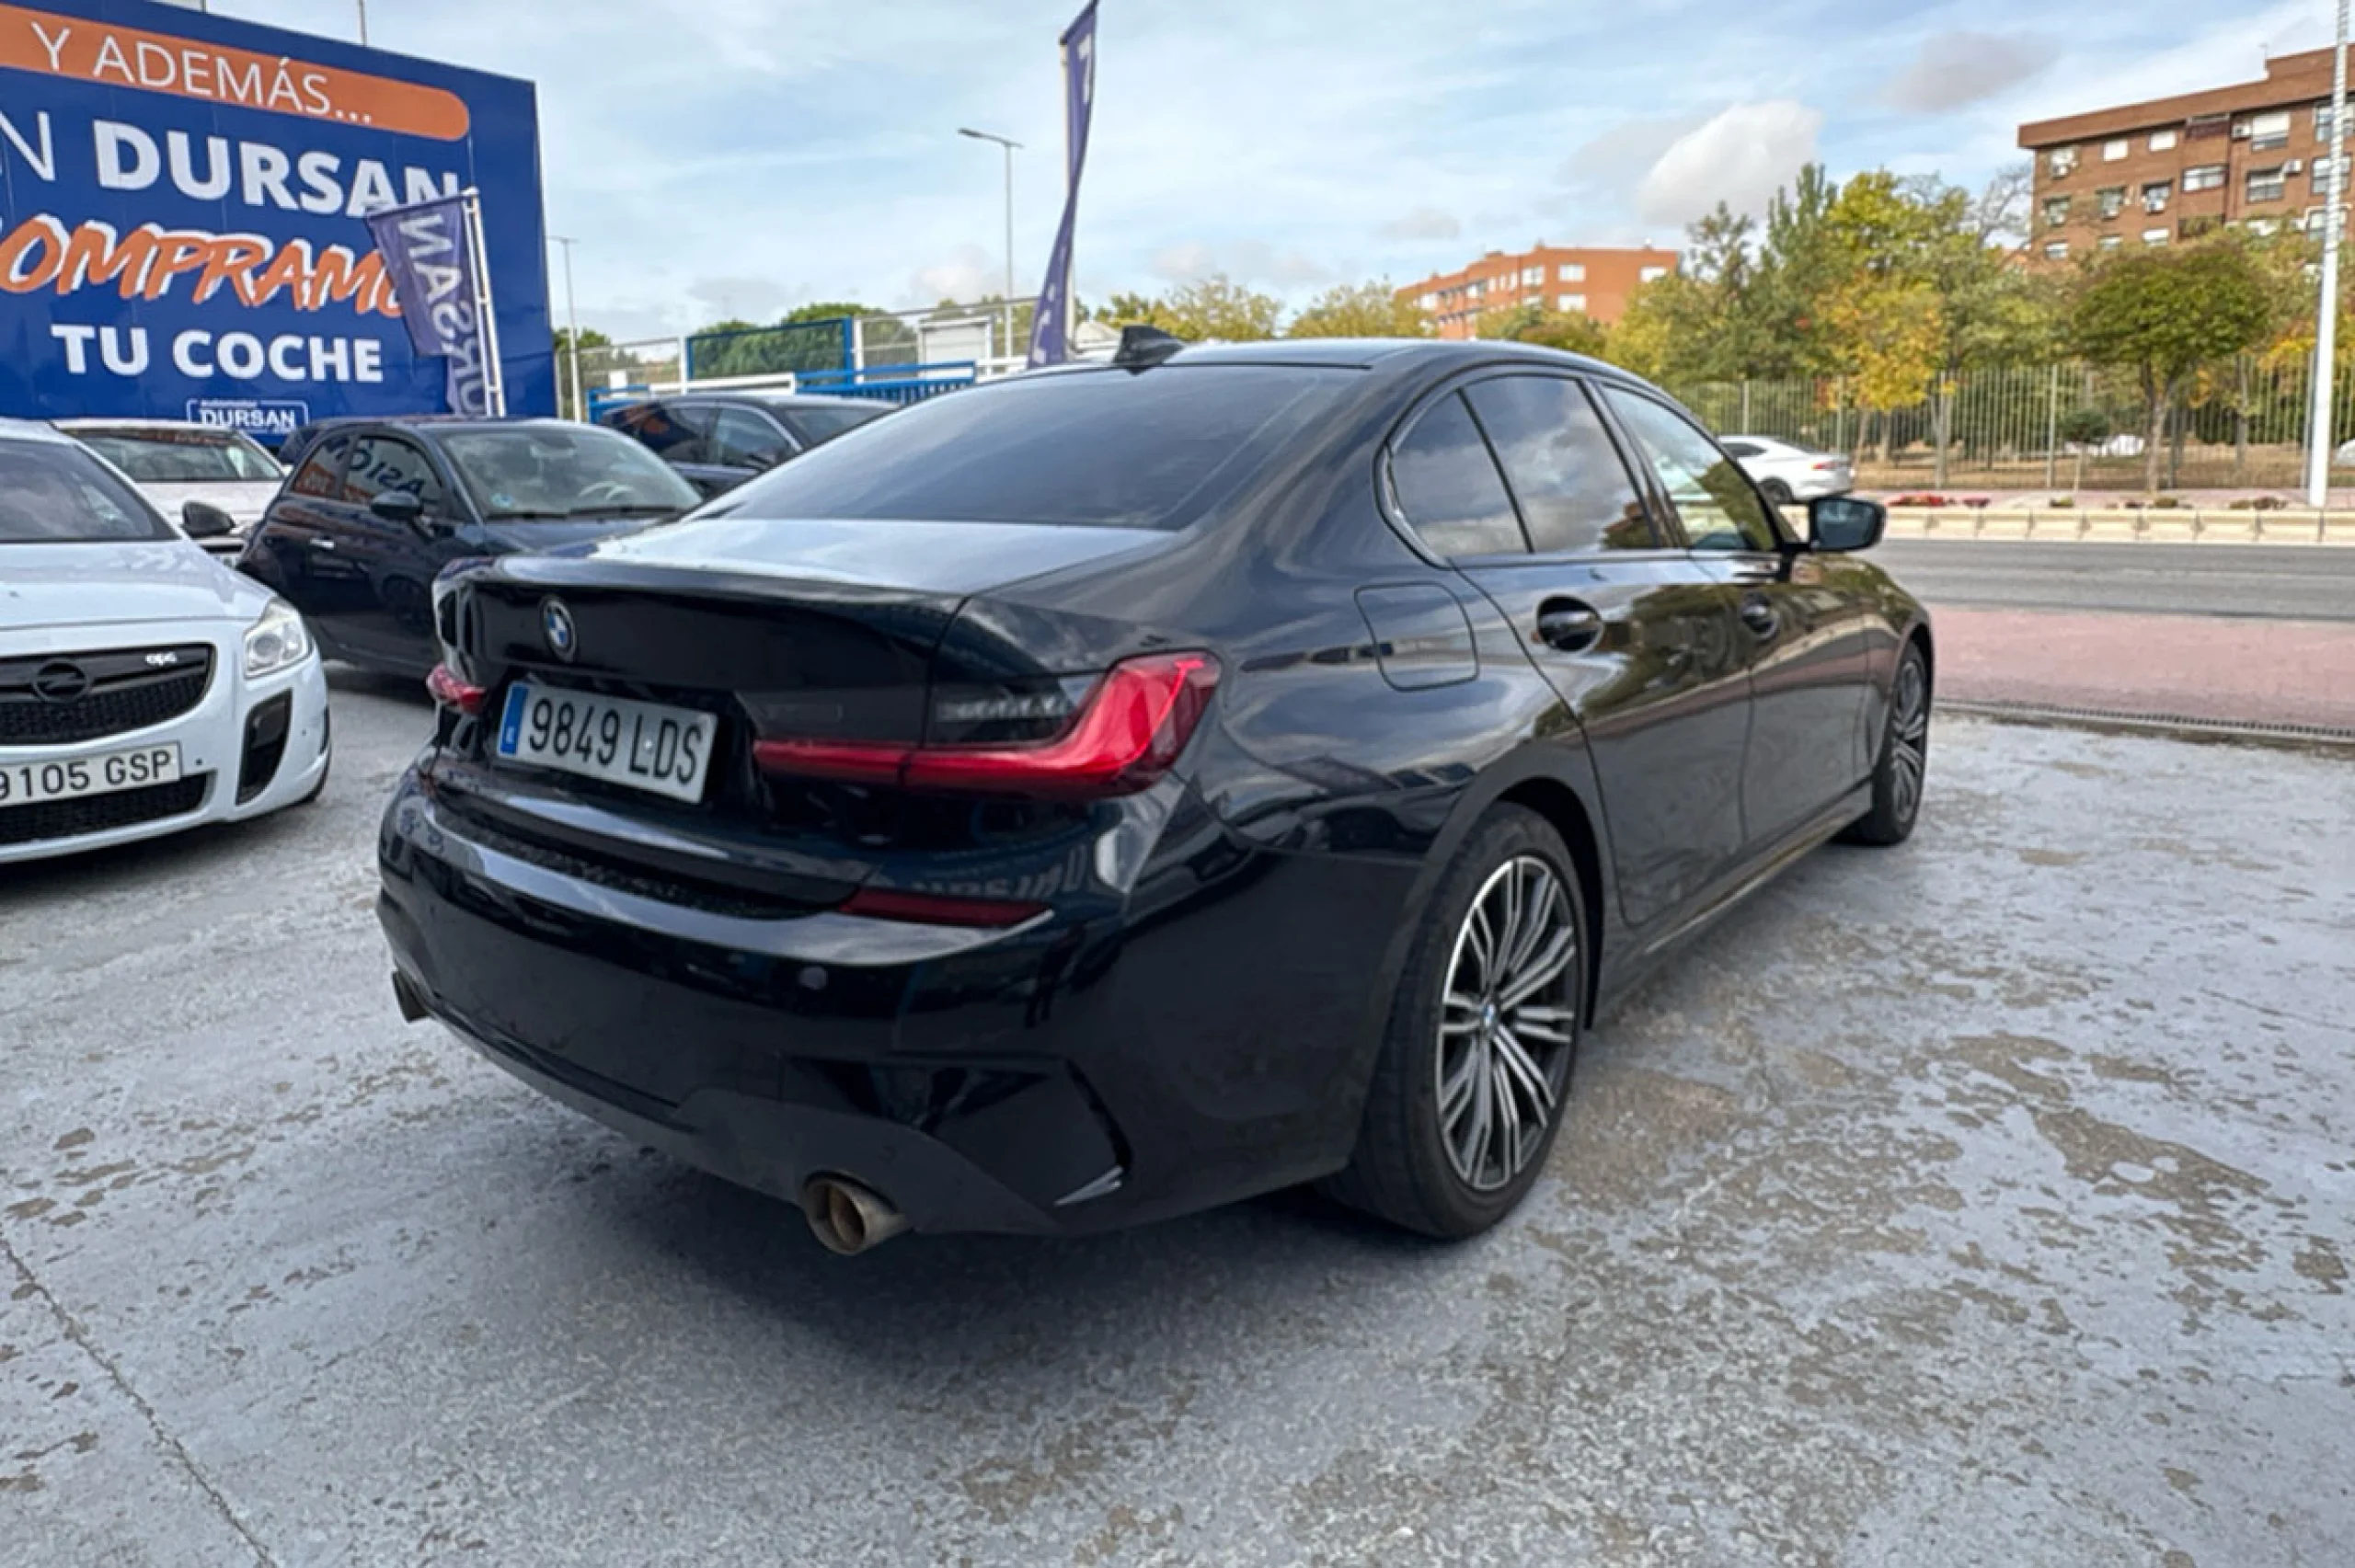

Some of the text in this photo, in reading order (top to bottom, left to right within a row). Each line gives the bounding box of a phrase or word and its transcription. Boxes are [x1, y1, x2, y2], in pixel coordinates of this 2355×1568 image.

[31, 21, 372, 123] Y ADEMÁS...
[51, 325, 383, 383] TU COCHE
[200, 409, 295, 429] DURSAN
[105, 750, 171, 785] GSP
[529, 698, 702, 786] 9849 LDS
